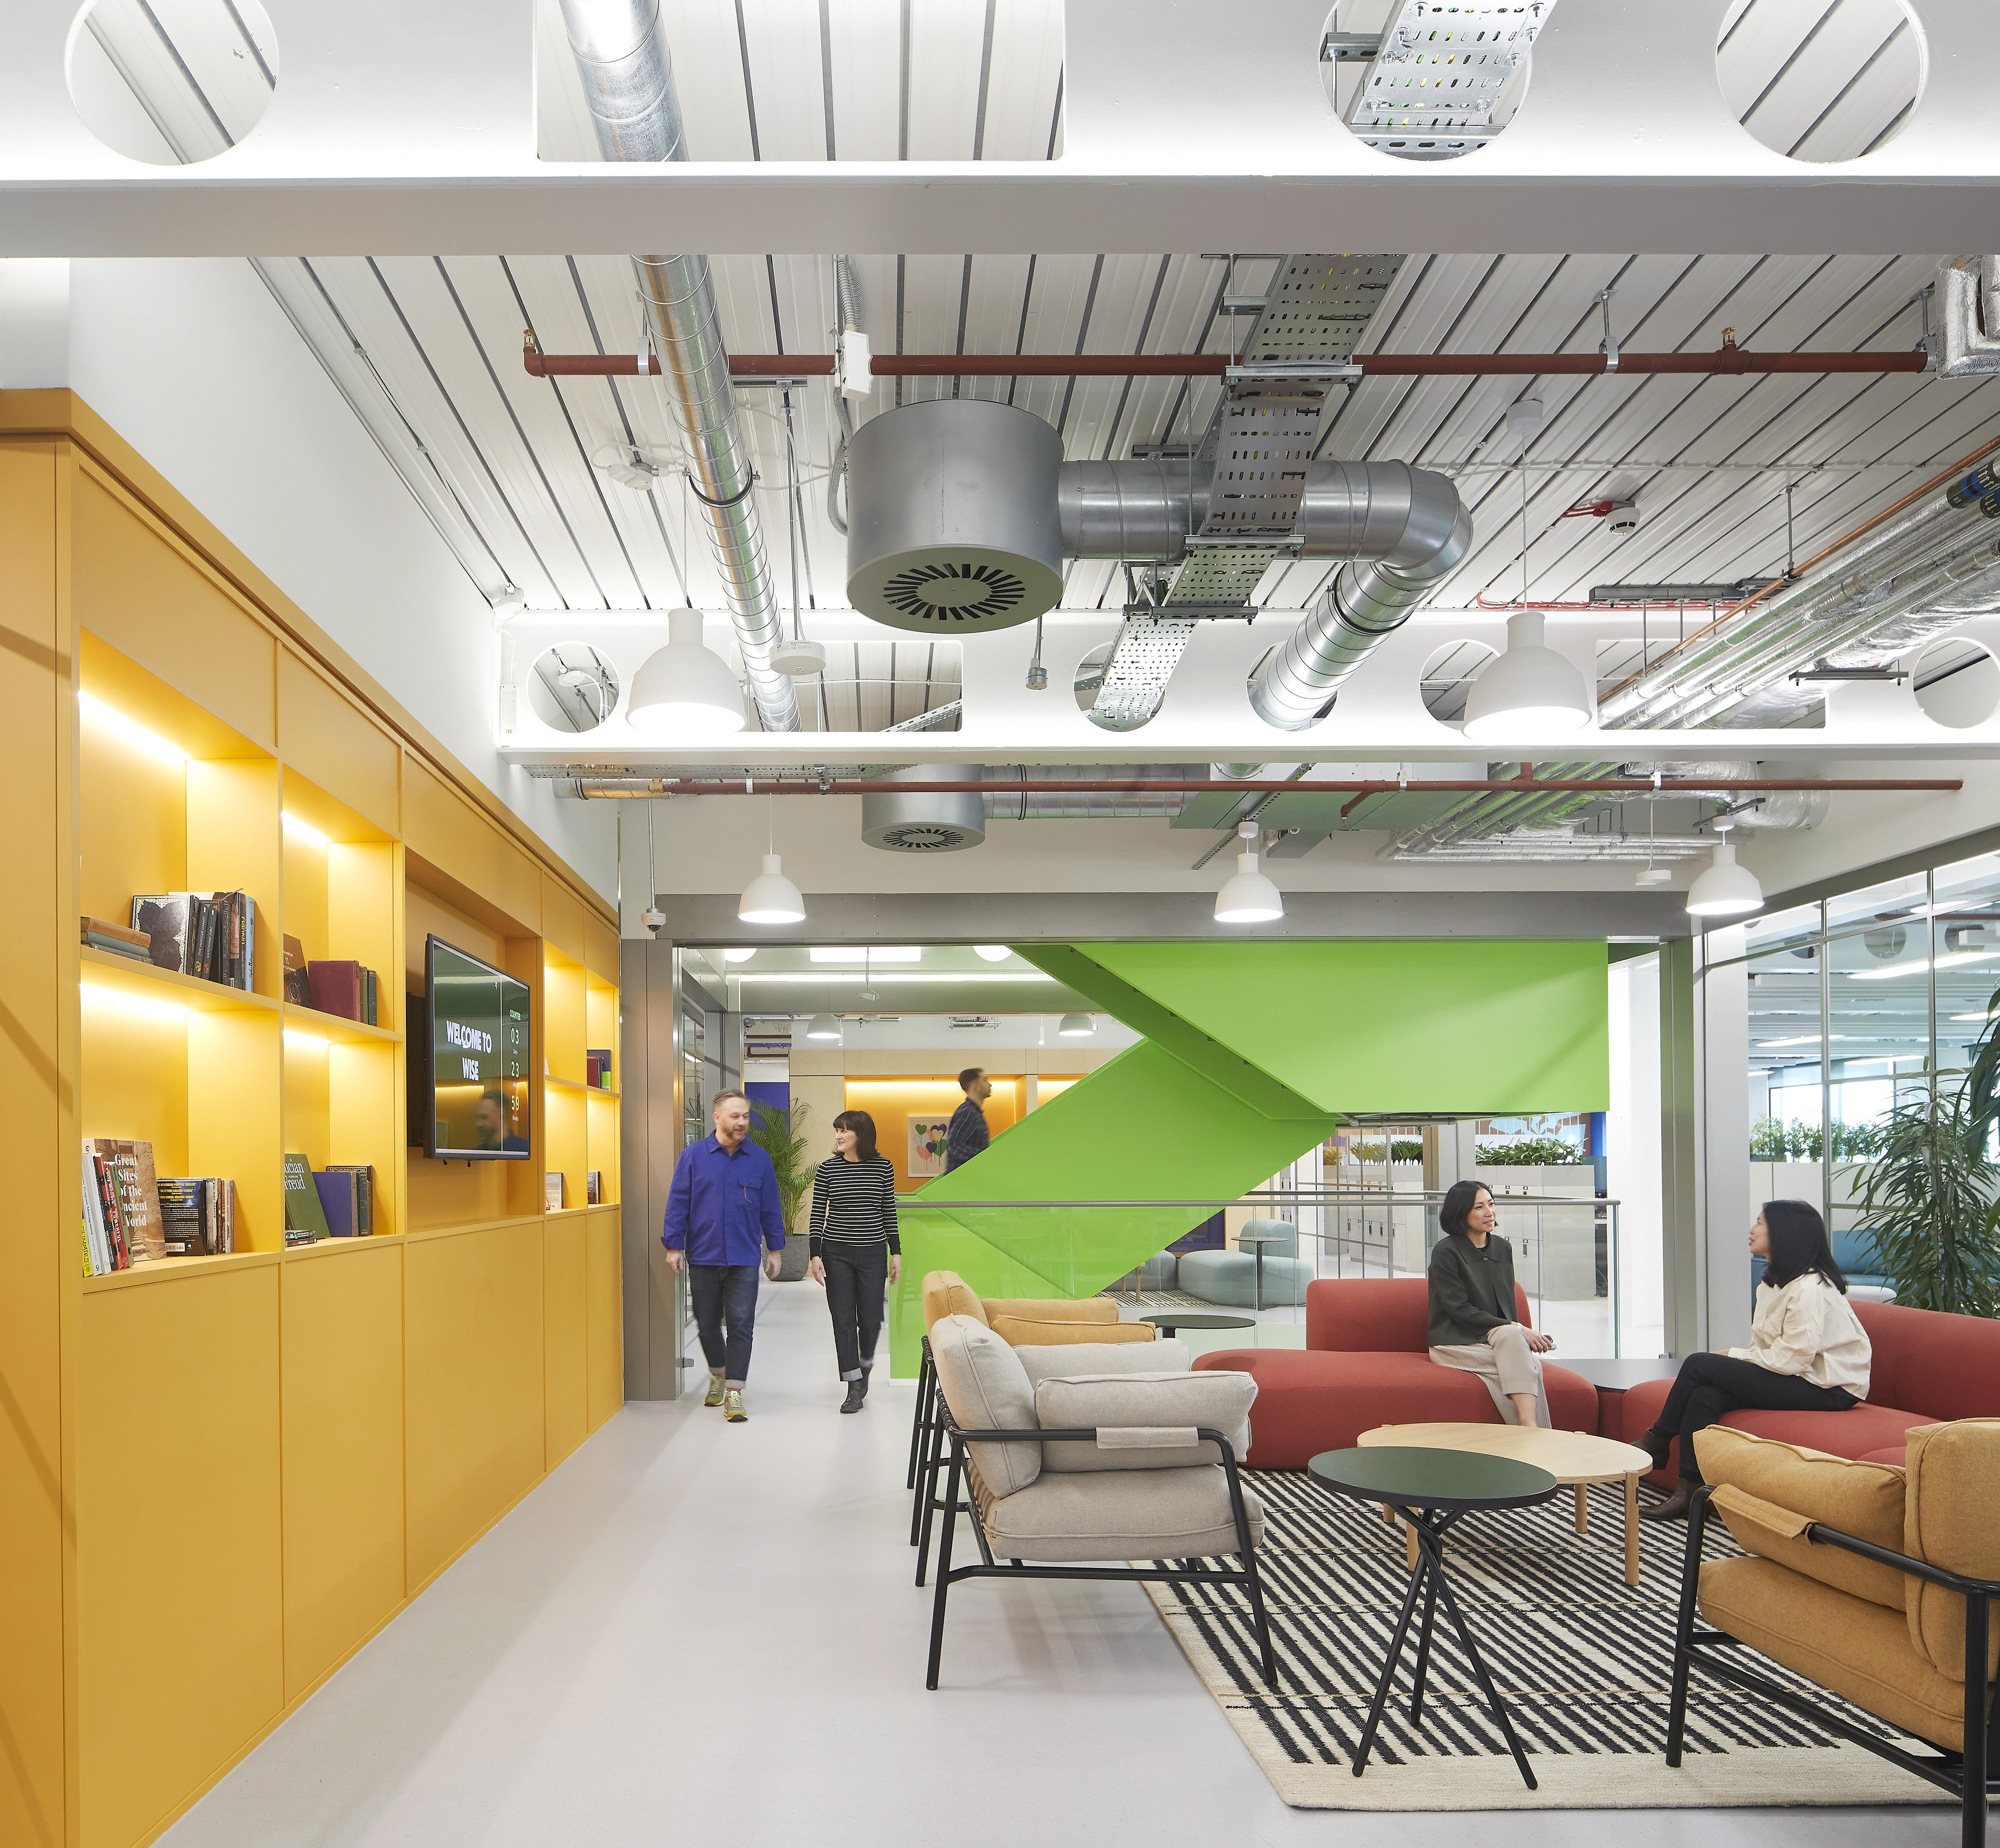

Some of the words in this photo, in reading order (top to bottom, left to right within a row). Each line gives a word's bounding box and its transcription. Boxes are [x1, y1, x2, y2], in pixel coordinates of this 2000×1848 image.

[510, 1009, 521, 1021] COUNTER
[446, 1020, 482, 1051] WELCOME
[482, 1031, 492, 1054] TO
[511, 1027, 519, 1045] 03
[462, 1057, 479, 1081] WISE
[511, 1061, 519, 1078] 23
[511, 1095, 519, 1111] 59
[115, 1154, 137, 1166] Great
[284, 1158, 304, 1173] ucian
[119, 1169, 138, 1181] Sites
[120, 1184, 127, 1196] of
[129, 1184, 142, 1196] the
[123, 1200, 148, 1212] ncient
[112, 1211, 121, 1242] POWERFUL
